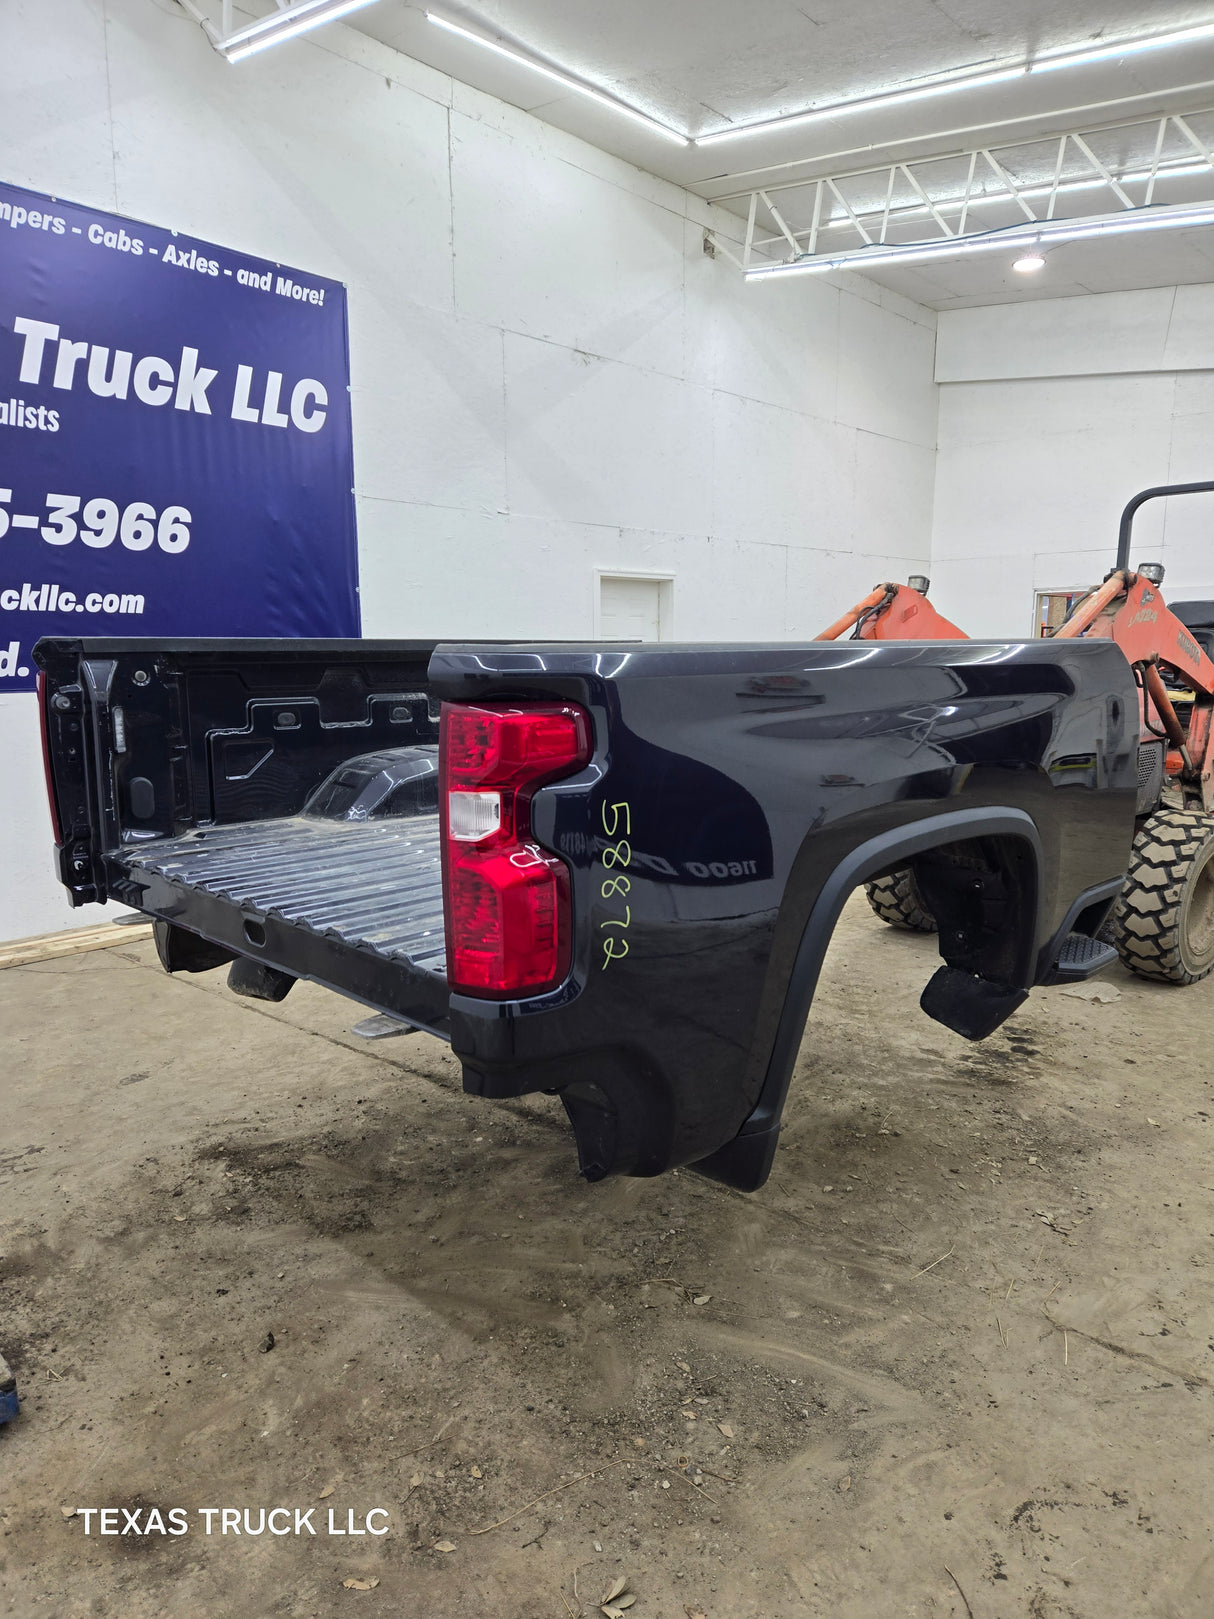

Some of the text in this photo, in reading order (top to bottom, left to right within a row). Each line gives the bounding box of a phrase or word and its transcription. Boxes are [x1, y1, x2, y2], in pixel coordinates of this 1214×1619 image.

[87, 223, 145, 256] Cabs
[161, 244, 220, 277] Axles
[236, 268, 273, 292] and
[275, 276, 325, 307] More!
[13, 316, 329, 433] Truck LLC
[0, 583, 145, 615] ckllc.com
[600, 799, 632, 970] 58872
